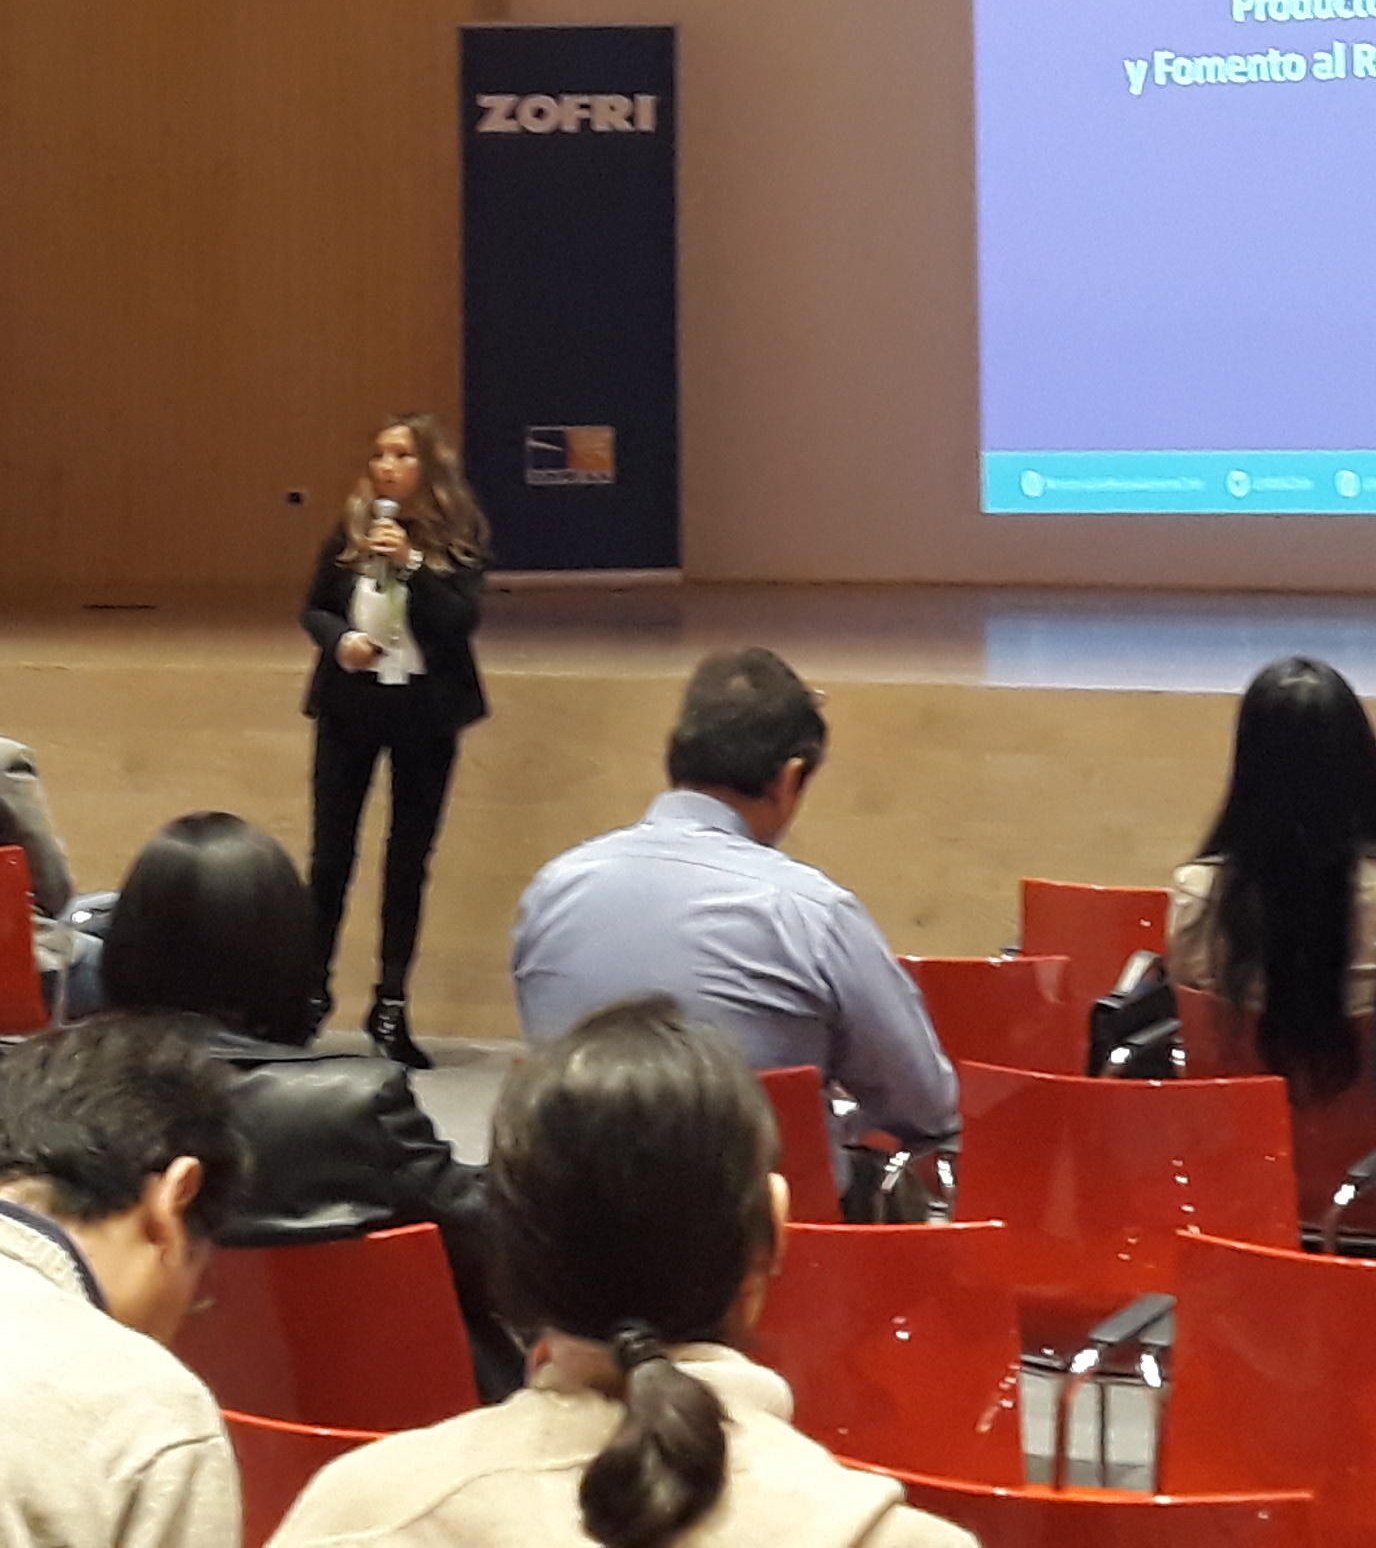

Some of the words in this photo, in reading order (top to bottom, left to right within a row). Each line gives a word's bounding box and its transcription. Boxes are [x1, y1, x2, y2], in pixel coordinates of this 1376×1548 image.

[1124, 57, 1148, 96] y
[1153, 48, 1306, 87] Fomento
[1313, 41, 1347, 80] al
[476, 93, 657, 134] ZOFRI
